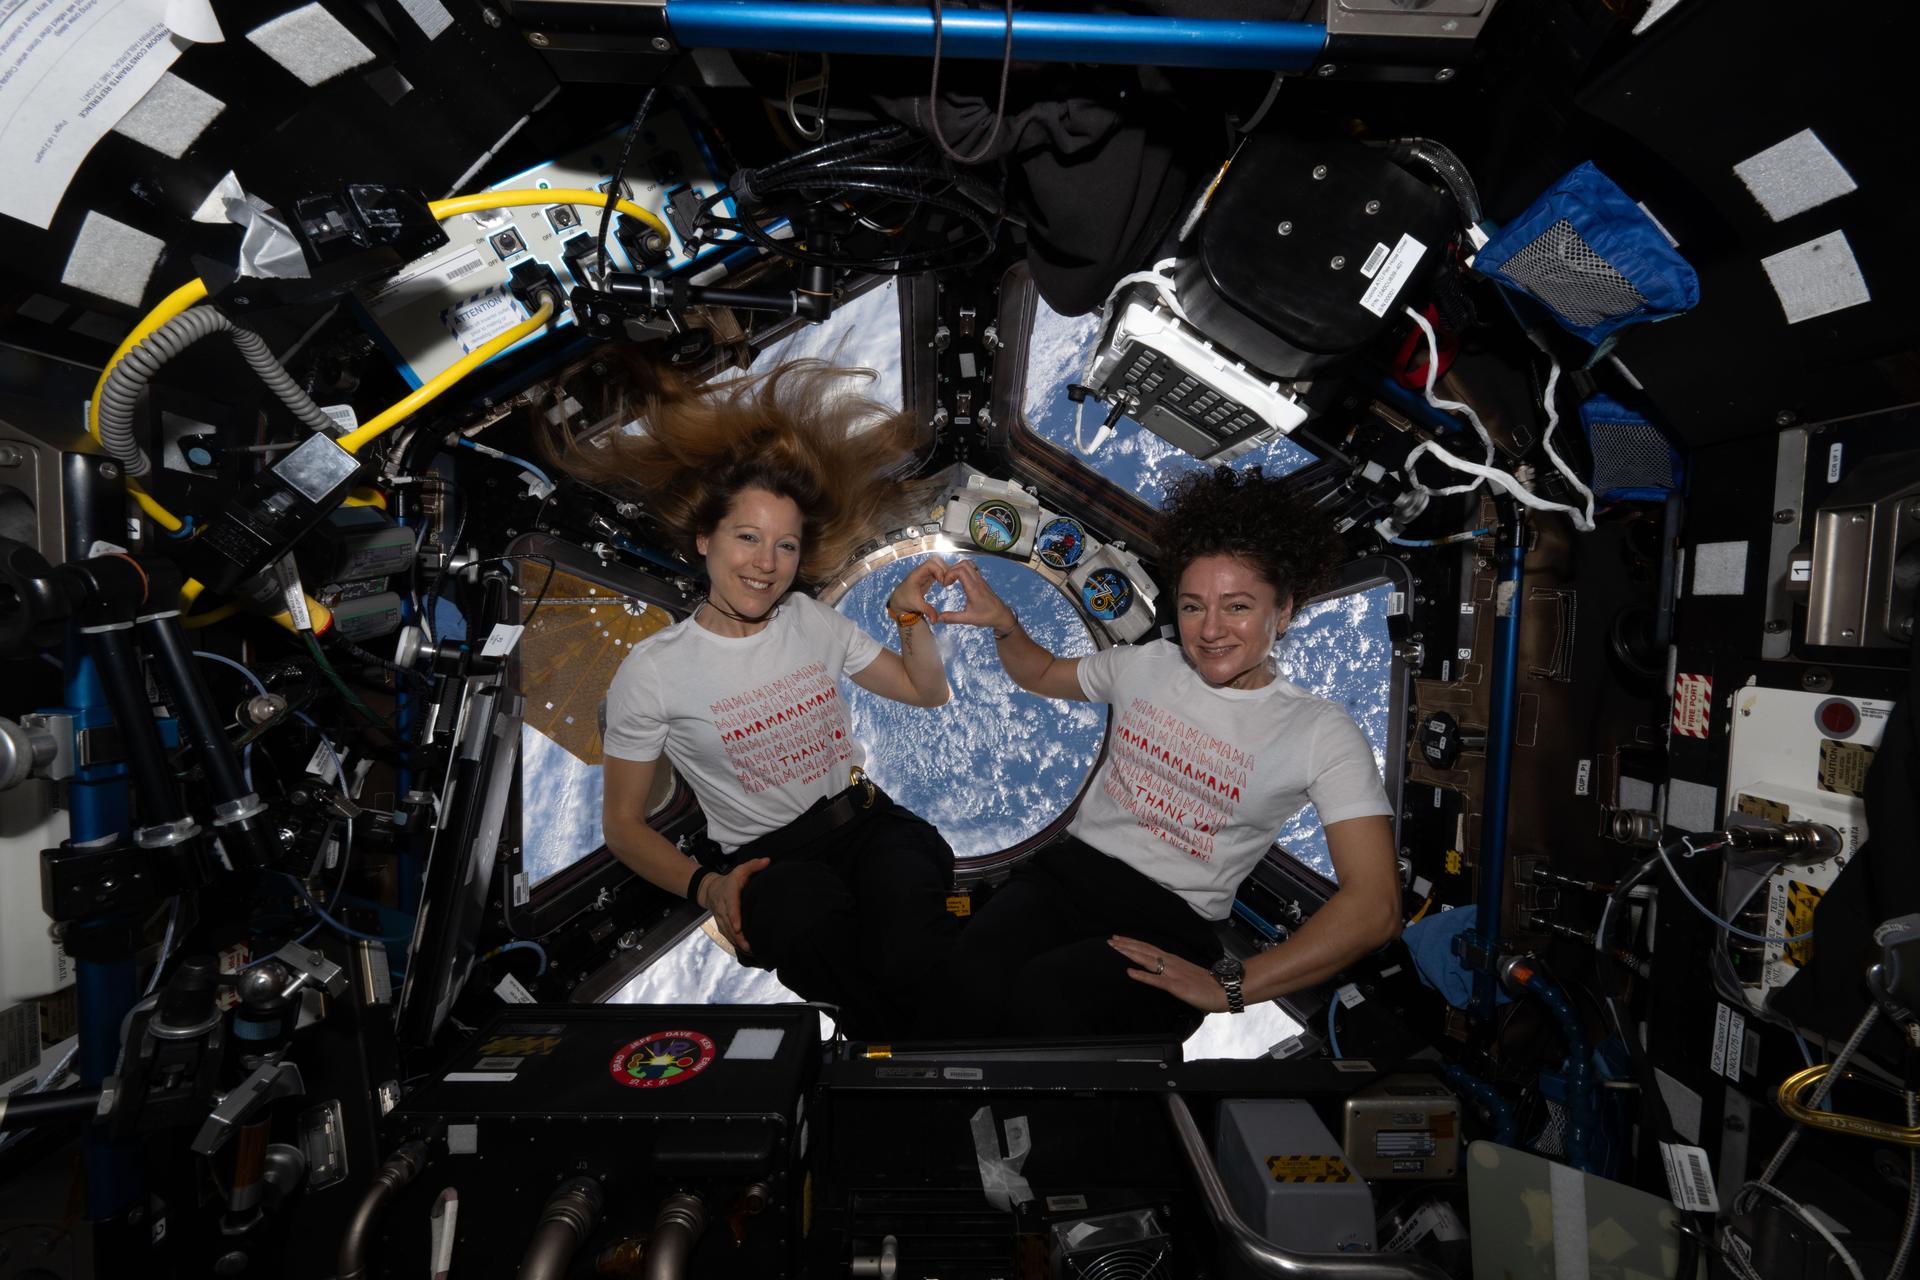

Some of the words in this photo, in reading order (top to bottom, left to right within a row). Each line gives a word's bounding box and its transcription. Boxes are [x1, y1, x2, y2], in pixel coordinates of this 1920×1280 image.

[107, 45, 148, 88] CONSTRAINTS
[77, 83, 112, 120] REFERENCE
[646, 183, 656, 192] OFF
[530, 210, 539, 218] ON
[594, 207, 605, 216] OF
[475, 236, 485, 244] ON
[542, 232, 552, 241] OFF
[487, 258, 498, 267] OFF
[1374, 275, 1384, 286] ATU
[452, 295, 502, 324] ATTENTION
[1689, 683, 1698, 706] PORT
[721, 687, 838, 744] MAMAMAMAMAMA
[1687, 708, 1696, 727] FIRE
[779, 740, 828, 767] THANK
[828, 728, 847, 742] YOU
[1116, 725, 1240, 802] MAMAMAMAMAMA
[1826, 746, 1838, 784] CAUTION
[802, 774, 821, 785] HAVE
[1135, 785, 1187, 825] THANK
[1193, 818, 1220, 837] YOU
[1138, 821, 1160, 835] HAVE
[1170, 837, 1188, 851] NICE
[1769, 896, 1778, 913] TEST
[1775, 894, 1787, 920] SELECT
[1763, 959, 1773, 984] POWER
[1771, 969, 1780, 982] OUT
[613, 1054, 624, 1072] BRAD
[576, 1159, 587, 1169] J3
